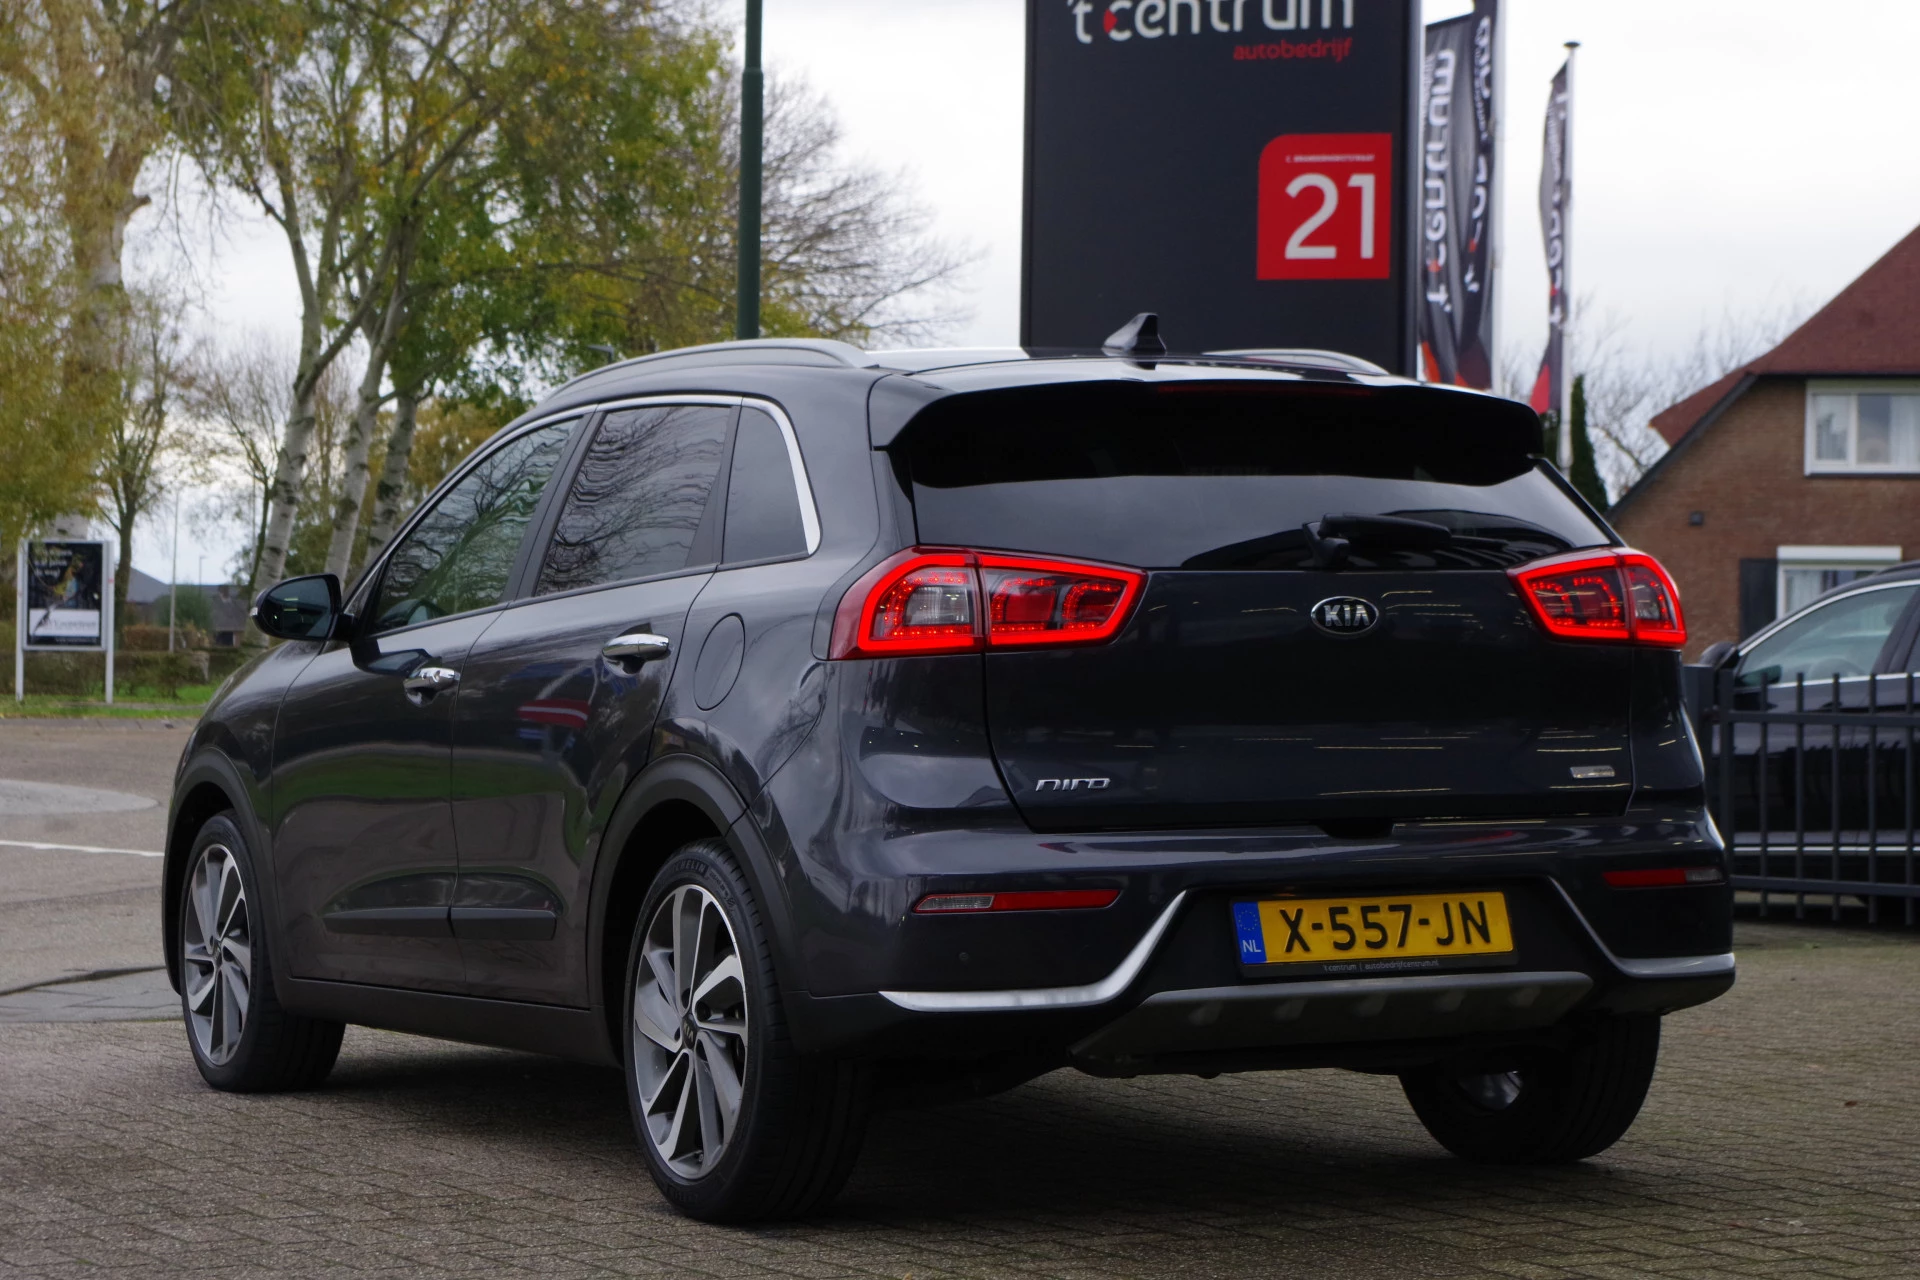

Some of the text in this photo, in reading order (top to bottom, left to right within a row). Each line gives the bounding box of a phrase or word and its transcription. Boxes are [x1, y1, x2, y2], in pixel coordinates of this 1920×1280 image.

[1103, 0, 1353, 41] centrum
[1233, 37, 1352, 61] autobedrijf
[1284, 172, 1375, 259] 21
[1323, 604, 1370, 626] KIA
[1279, 901, 1491, 953] X-557-JN
[1242, 940, 1261, 953] NL
